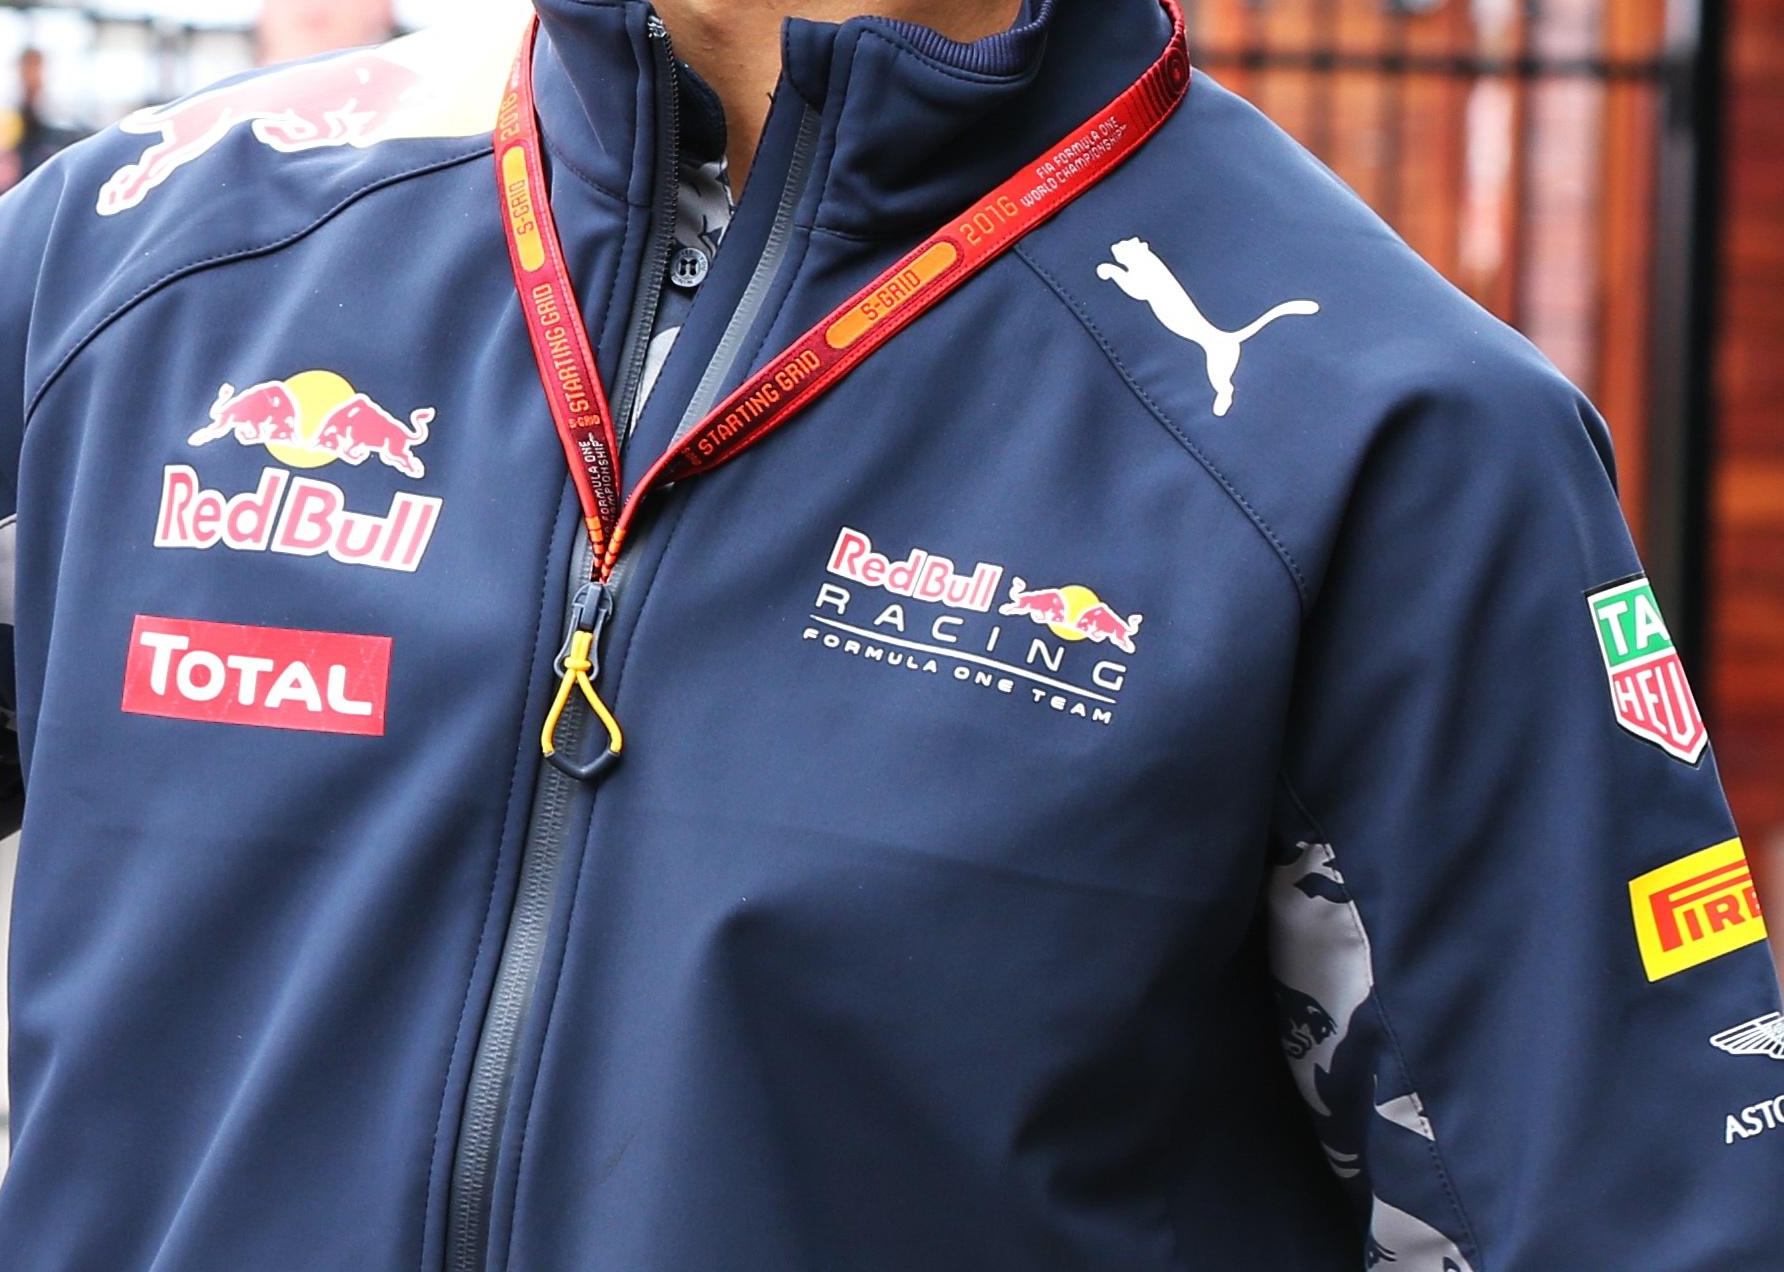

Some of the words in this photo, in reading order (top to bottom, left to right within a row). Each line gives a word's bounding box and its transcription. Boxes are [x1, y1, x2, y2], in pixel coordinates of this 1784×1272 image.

[1036, 161, 1056, 180] FIA
[1053, 130, 1101, 167] FORMULA
[1098, 115, 1120, 136] ONE
[508, 179, 534, 236] S-GRID
[959, 195, 1019, 245] 2016
[1019, 177, 1058, 208] WORLD
[532, 282, 562, 327] GRID
[860, 268, 921, 321] S-GRID
[544, 325, 590, 414] STARTING
[698, 382, 781, 456] STARTING
[774, 349, 821, 392] GRID
[578, 440, 597, 463] ONE
[586, 465, 610, 521] FORMULA
[815, 583, 1127, 691] RACING
[139, 631, 373, 716] TOTAL
[802, 626, 938, 674] FORMULA
[953, 665, 1014, 694] ONE
[1031, 687, 1113, 725] TEAM
